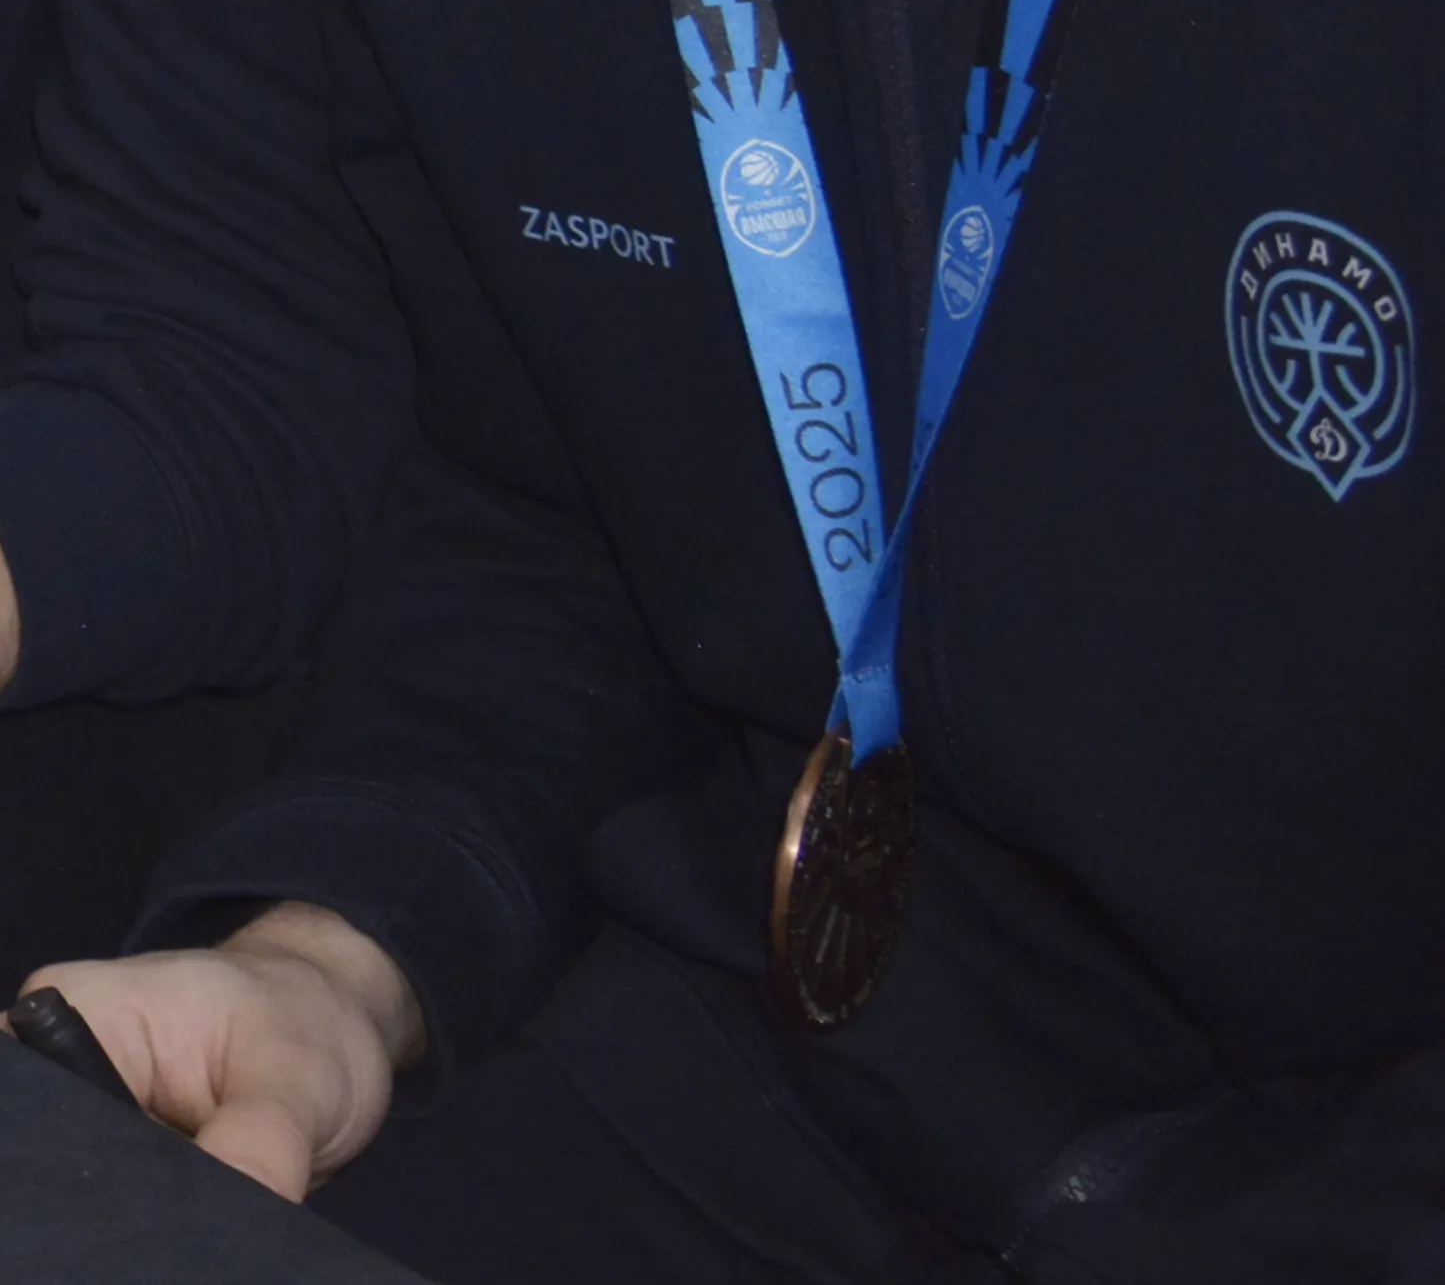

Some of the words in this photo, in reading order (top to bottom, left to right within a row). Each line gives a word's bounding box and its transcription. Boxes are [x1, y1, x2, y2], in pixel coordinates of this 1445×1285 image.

[519, 205, 676, 269] ZASPORT
[1240, 232, 1398, 322] ДИНАМО
[779, 362, 873, 572] 2025
